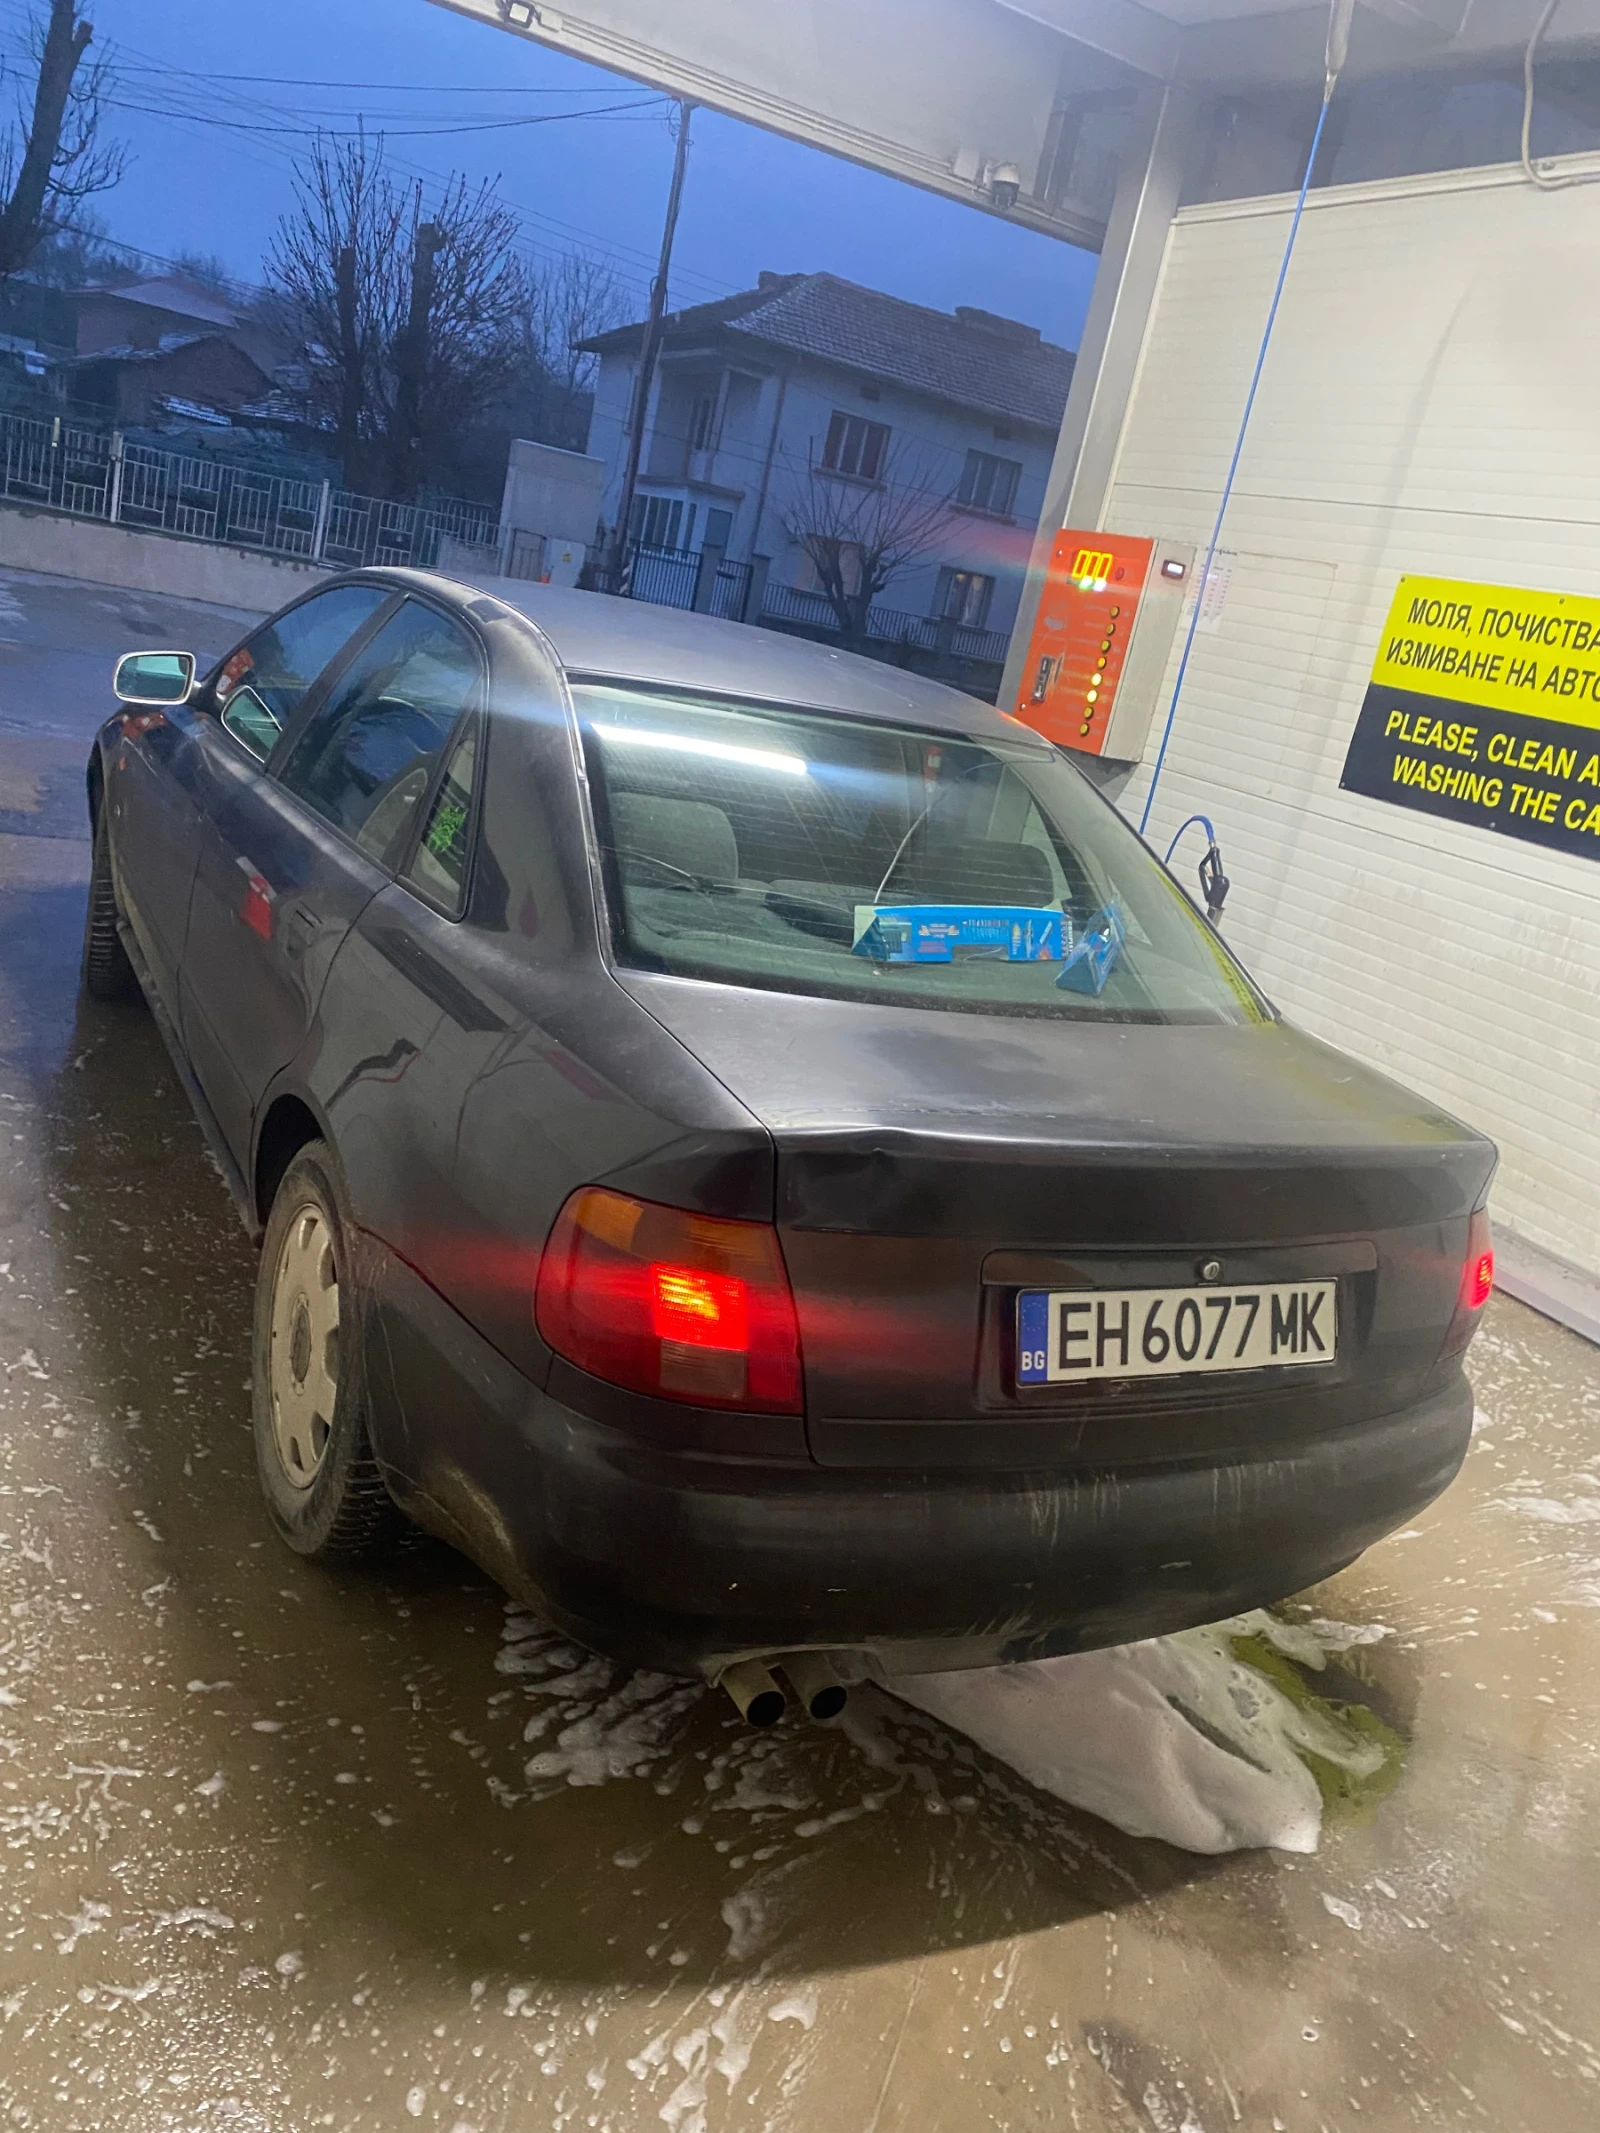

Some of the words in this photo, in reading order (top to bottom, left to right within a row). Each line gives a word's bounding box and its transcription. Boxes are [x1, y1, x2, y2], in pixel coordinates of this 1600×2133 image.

[1407, 597, 1472, 638] МОЛЯ,
[1386, 637, 1504, 683] ИЗМИВАНЕ
[1505, 658, 1537, 690] НА
[1385, 710, 1479, 763] PLEASE,
[1487, 733, 1578, 780] CLEAN
[1577, 754, 1600, 787] A
[1393, 754, 1503, 807] WASHING
[1509, 783, 1562, 824] THE
[1021, 1350, 1046, 1371] BG
[1059, 1301, 1129, 1370] EH
[1142, 1295, 1260, 1363] 6077
[1270, 1291, 1326, 1356] MK
